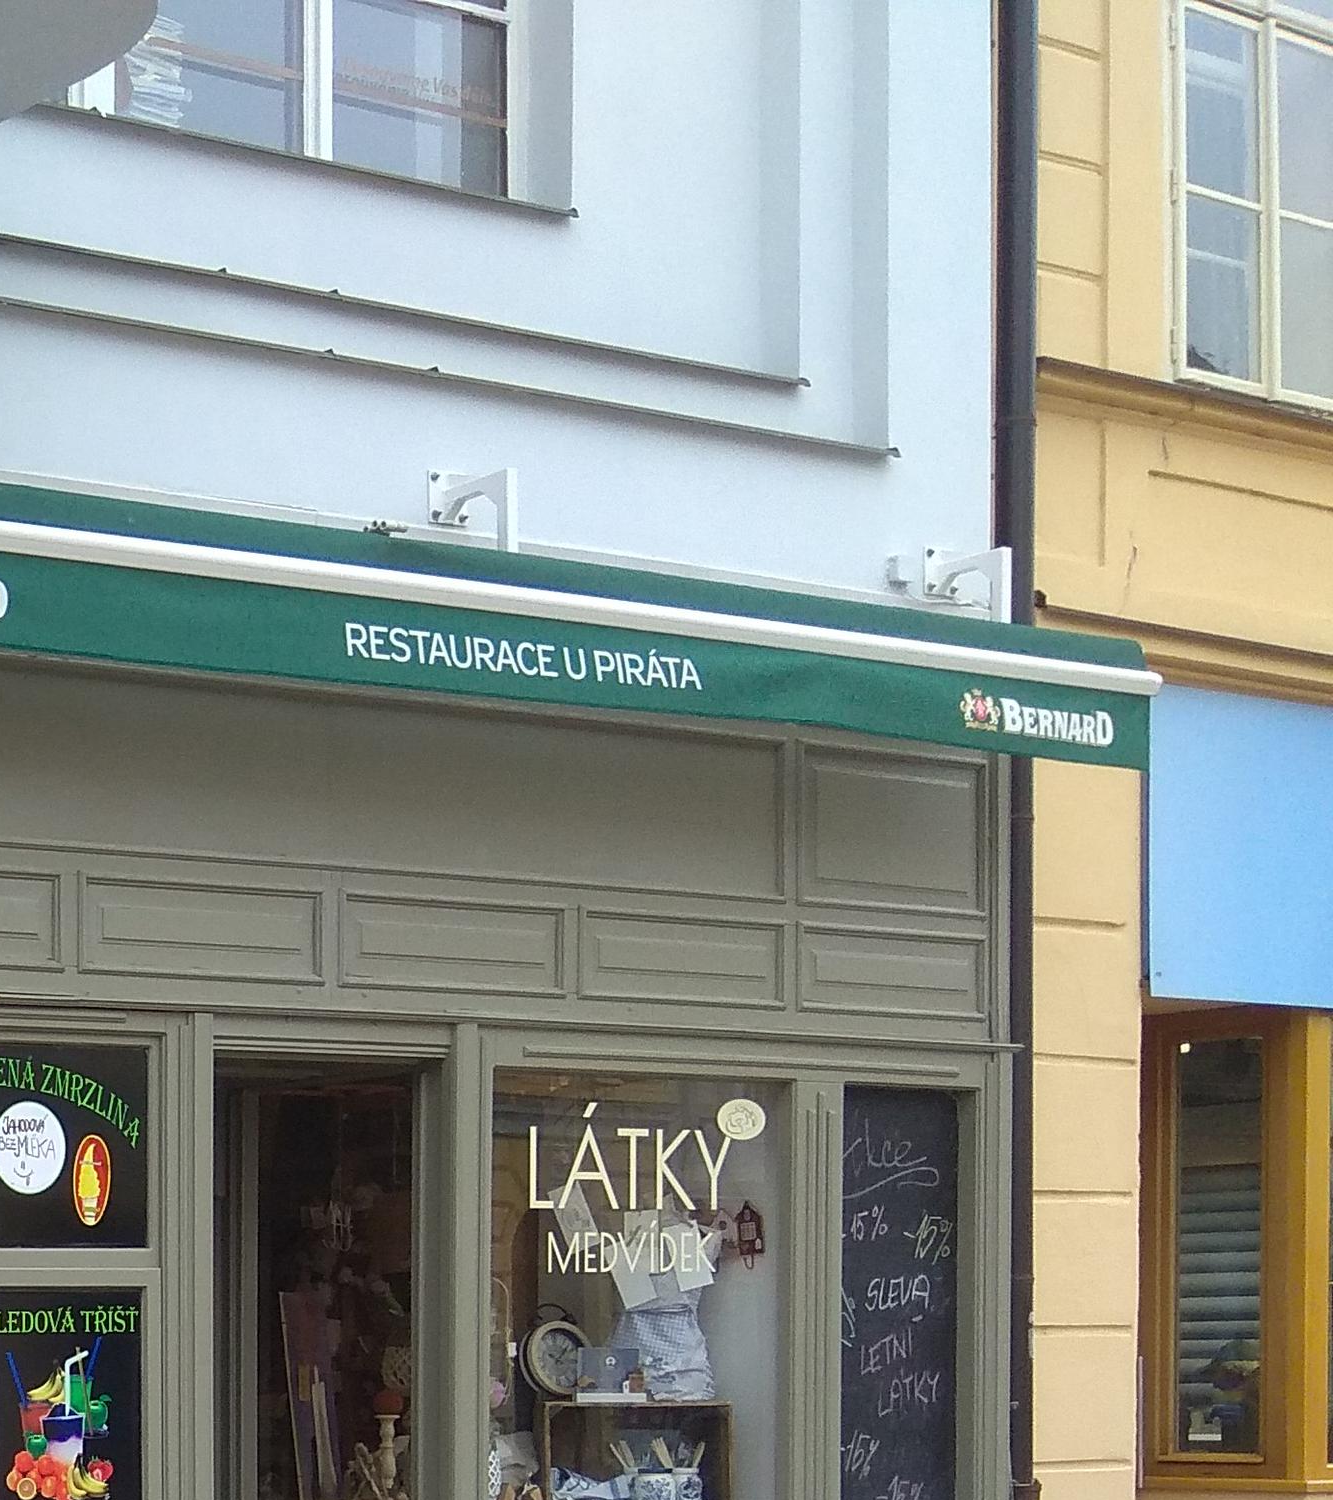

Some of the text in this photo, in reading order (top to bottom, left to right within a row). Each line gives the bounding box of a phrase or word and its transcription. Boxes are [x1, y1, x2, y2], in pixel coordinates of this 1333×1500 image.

[344, 621, 703, 692] RESTAURACE U PIRÁTA
[40, 1062, 141, 1150] ZMRZLINA
[528, 1101, 734, 1211] LÁTKY
[546, 1219, 717, 1274] MEDVÍDEK
[81, 1305, 139, 1333] TŘÍŠŤ
[865, 1274, 930, 1311] SLEVA
